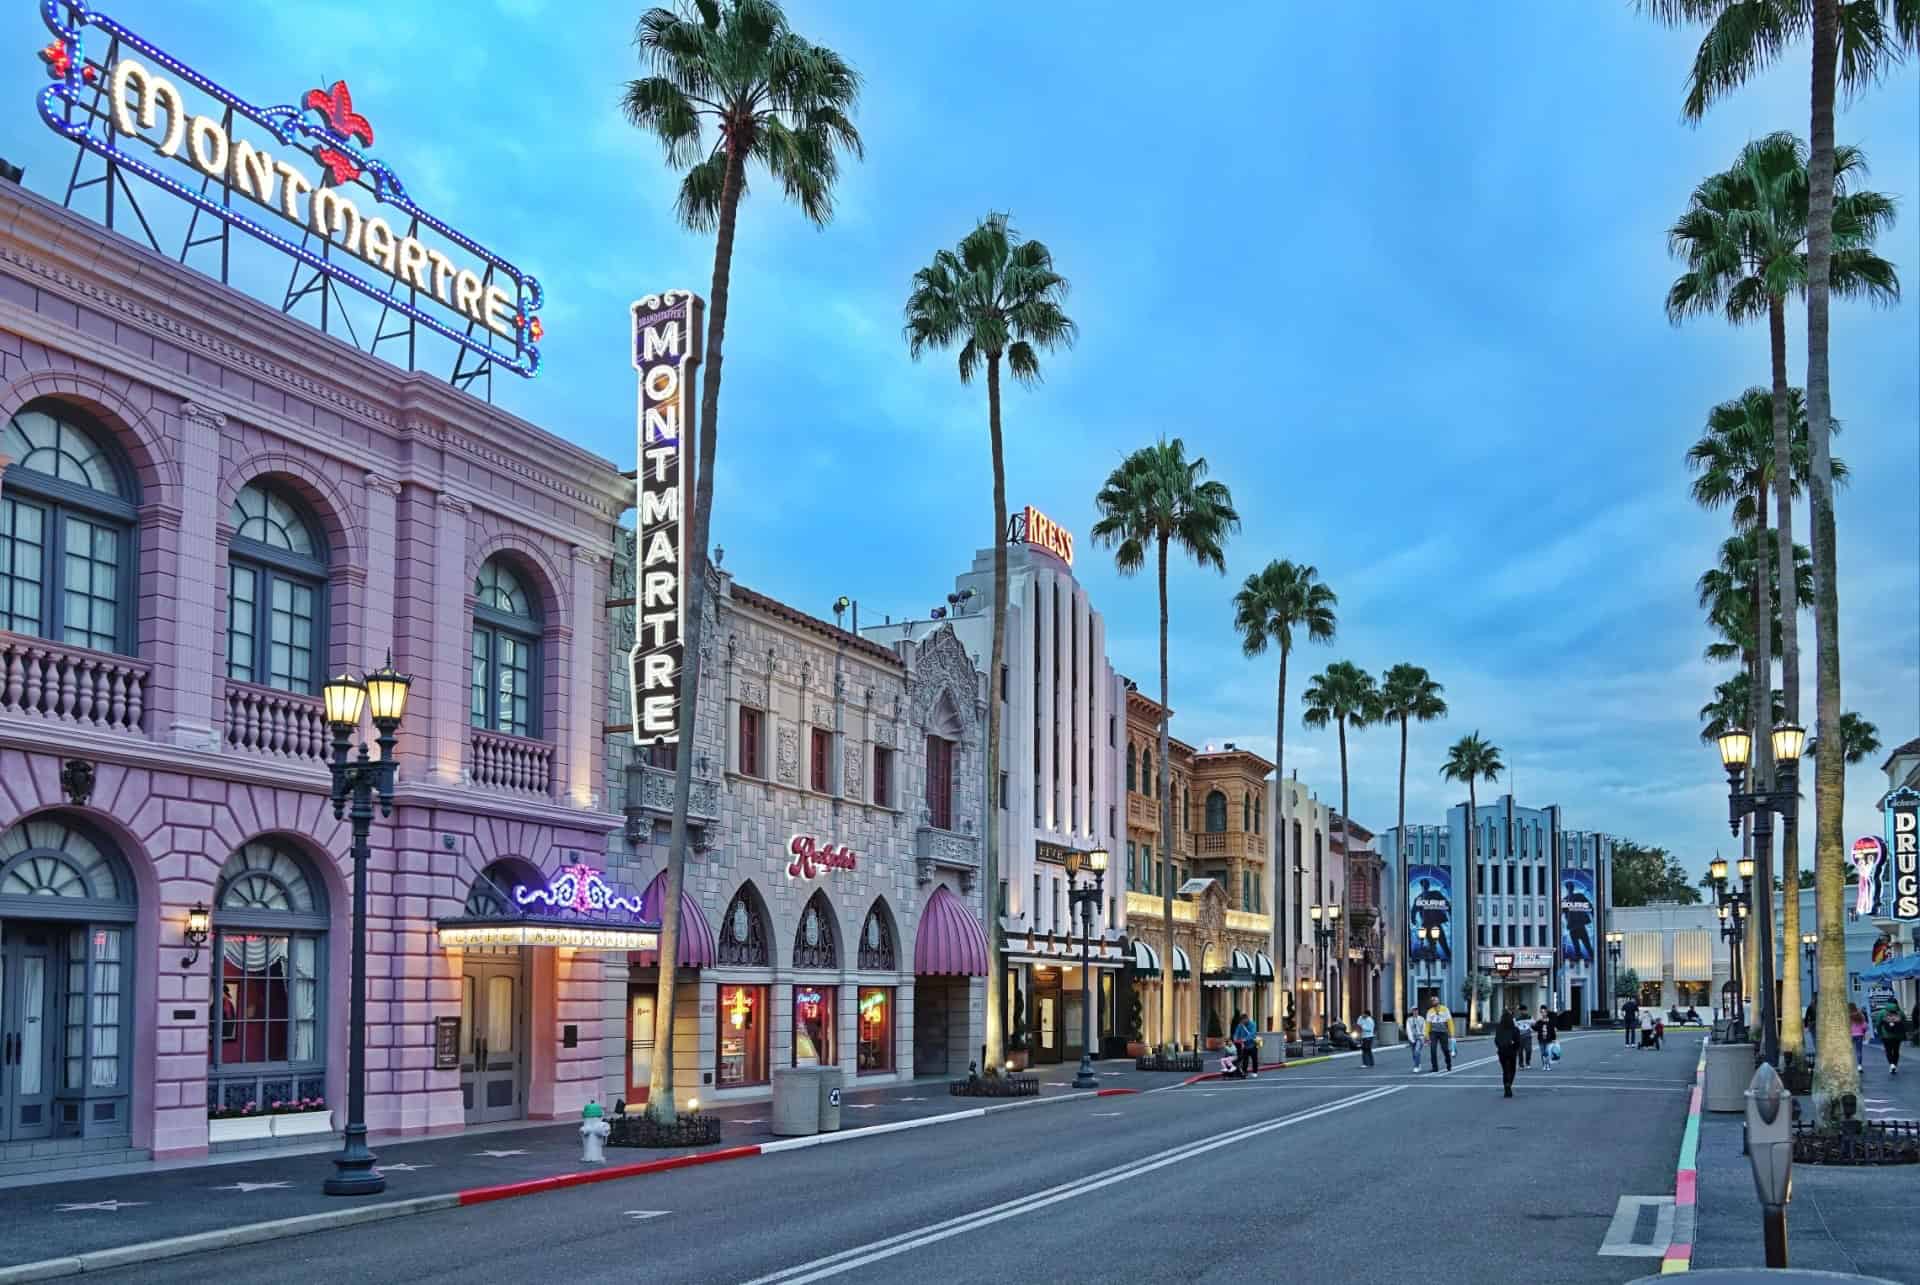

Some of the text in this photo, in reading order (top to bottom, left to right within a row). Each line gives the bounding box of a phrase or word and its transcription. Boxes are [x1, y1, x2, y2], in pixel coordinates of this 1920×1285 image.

[109, 60, 515, 336] MONTMARTRE
[641, 320, 679, 732] MONTMARTRE
[1027, 505, 1073, 567] KRESS
[1895, 812, 1919, 918] DRUGS
